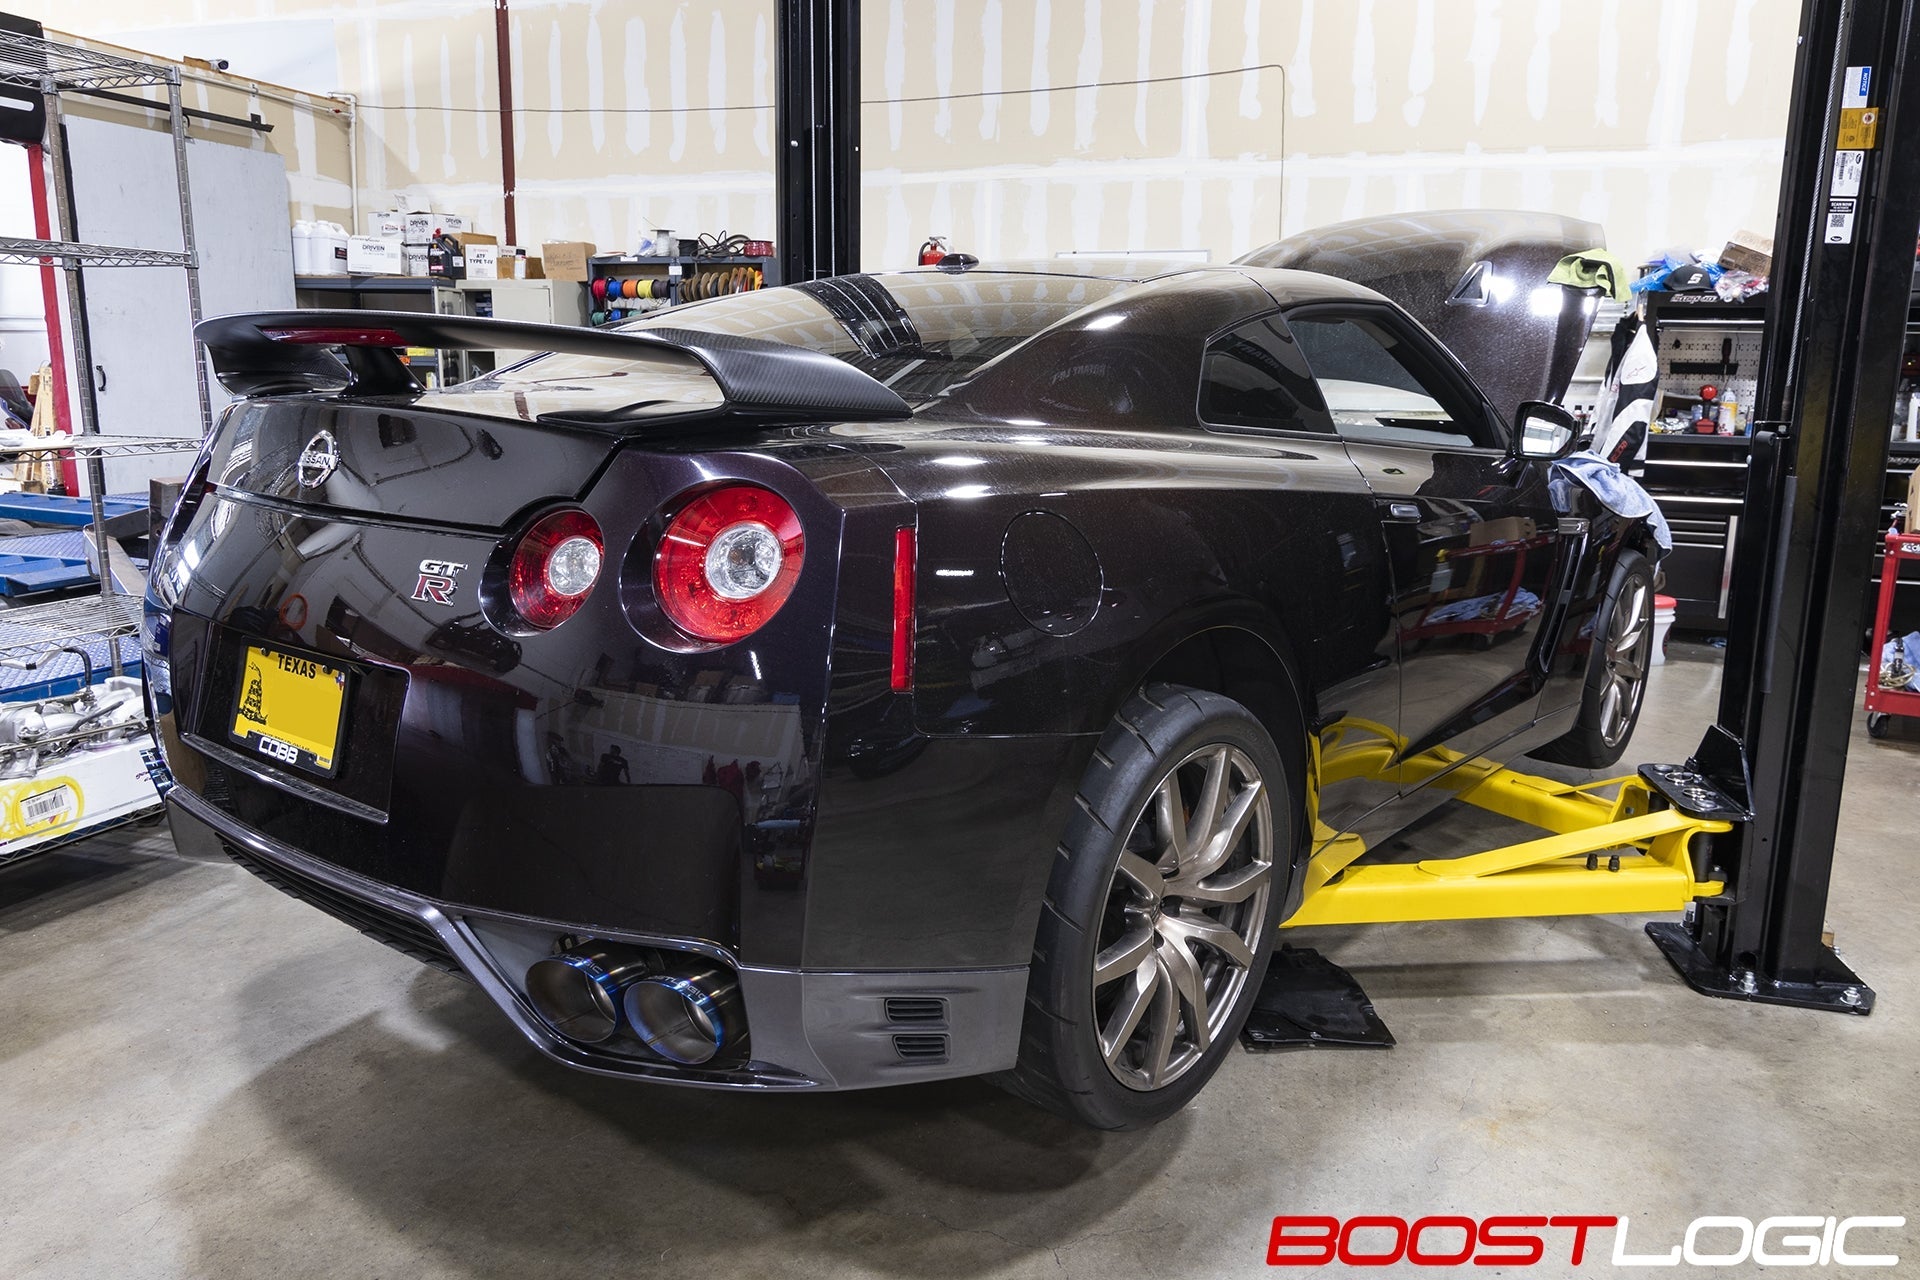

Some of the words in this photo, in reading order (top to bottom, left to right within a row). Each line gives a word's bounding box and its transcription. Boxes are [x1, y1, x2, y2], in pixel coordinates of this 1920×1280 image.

[1861, 72, 1869, 92] NOTICE
[409, 219, 429, 227] DRIVEN
[445, 216, 463, 225] DRIVEN
[362, 244, 386, 252] DRIVEN
[1670, 293, 1718, 304] Snap-on
[419, 559, 469, 577] GT
[411, 573, 456, 606] R
[277, 653, 317, 680] TEXAS
[259, 736, 298, 764] COBB
